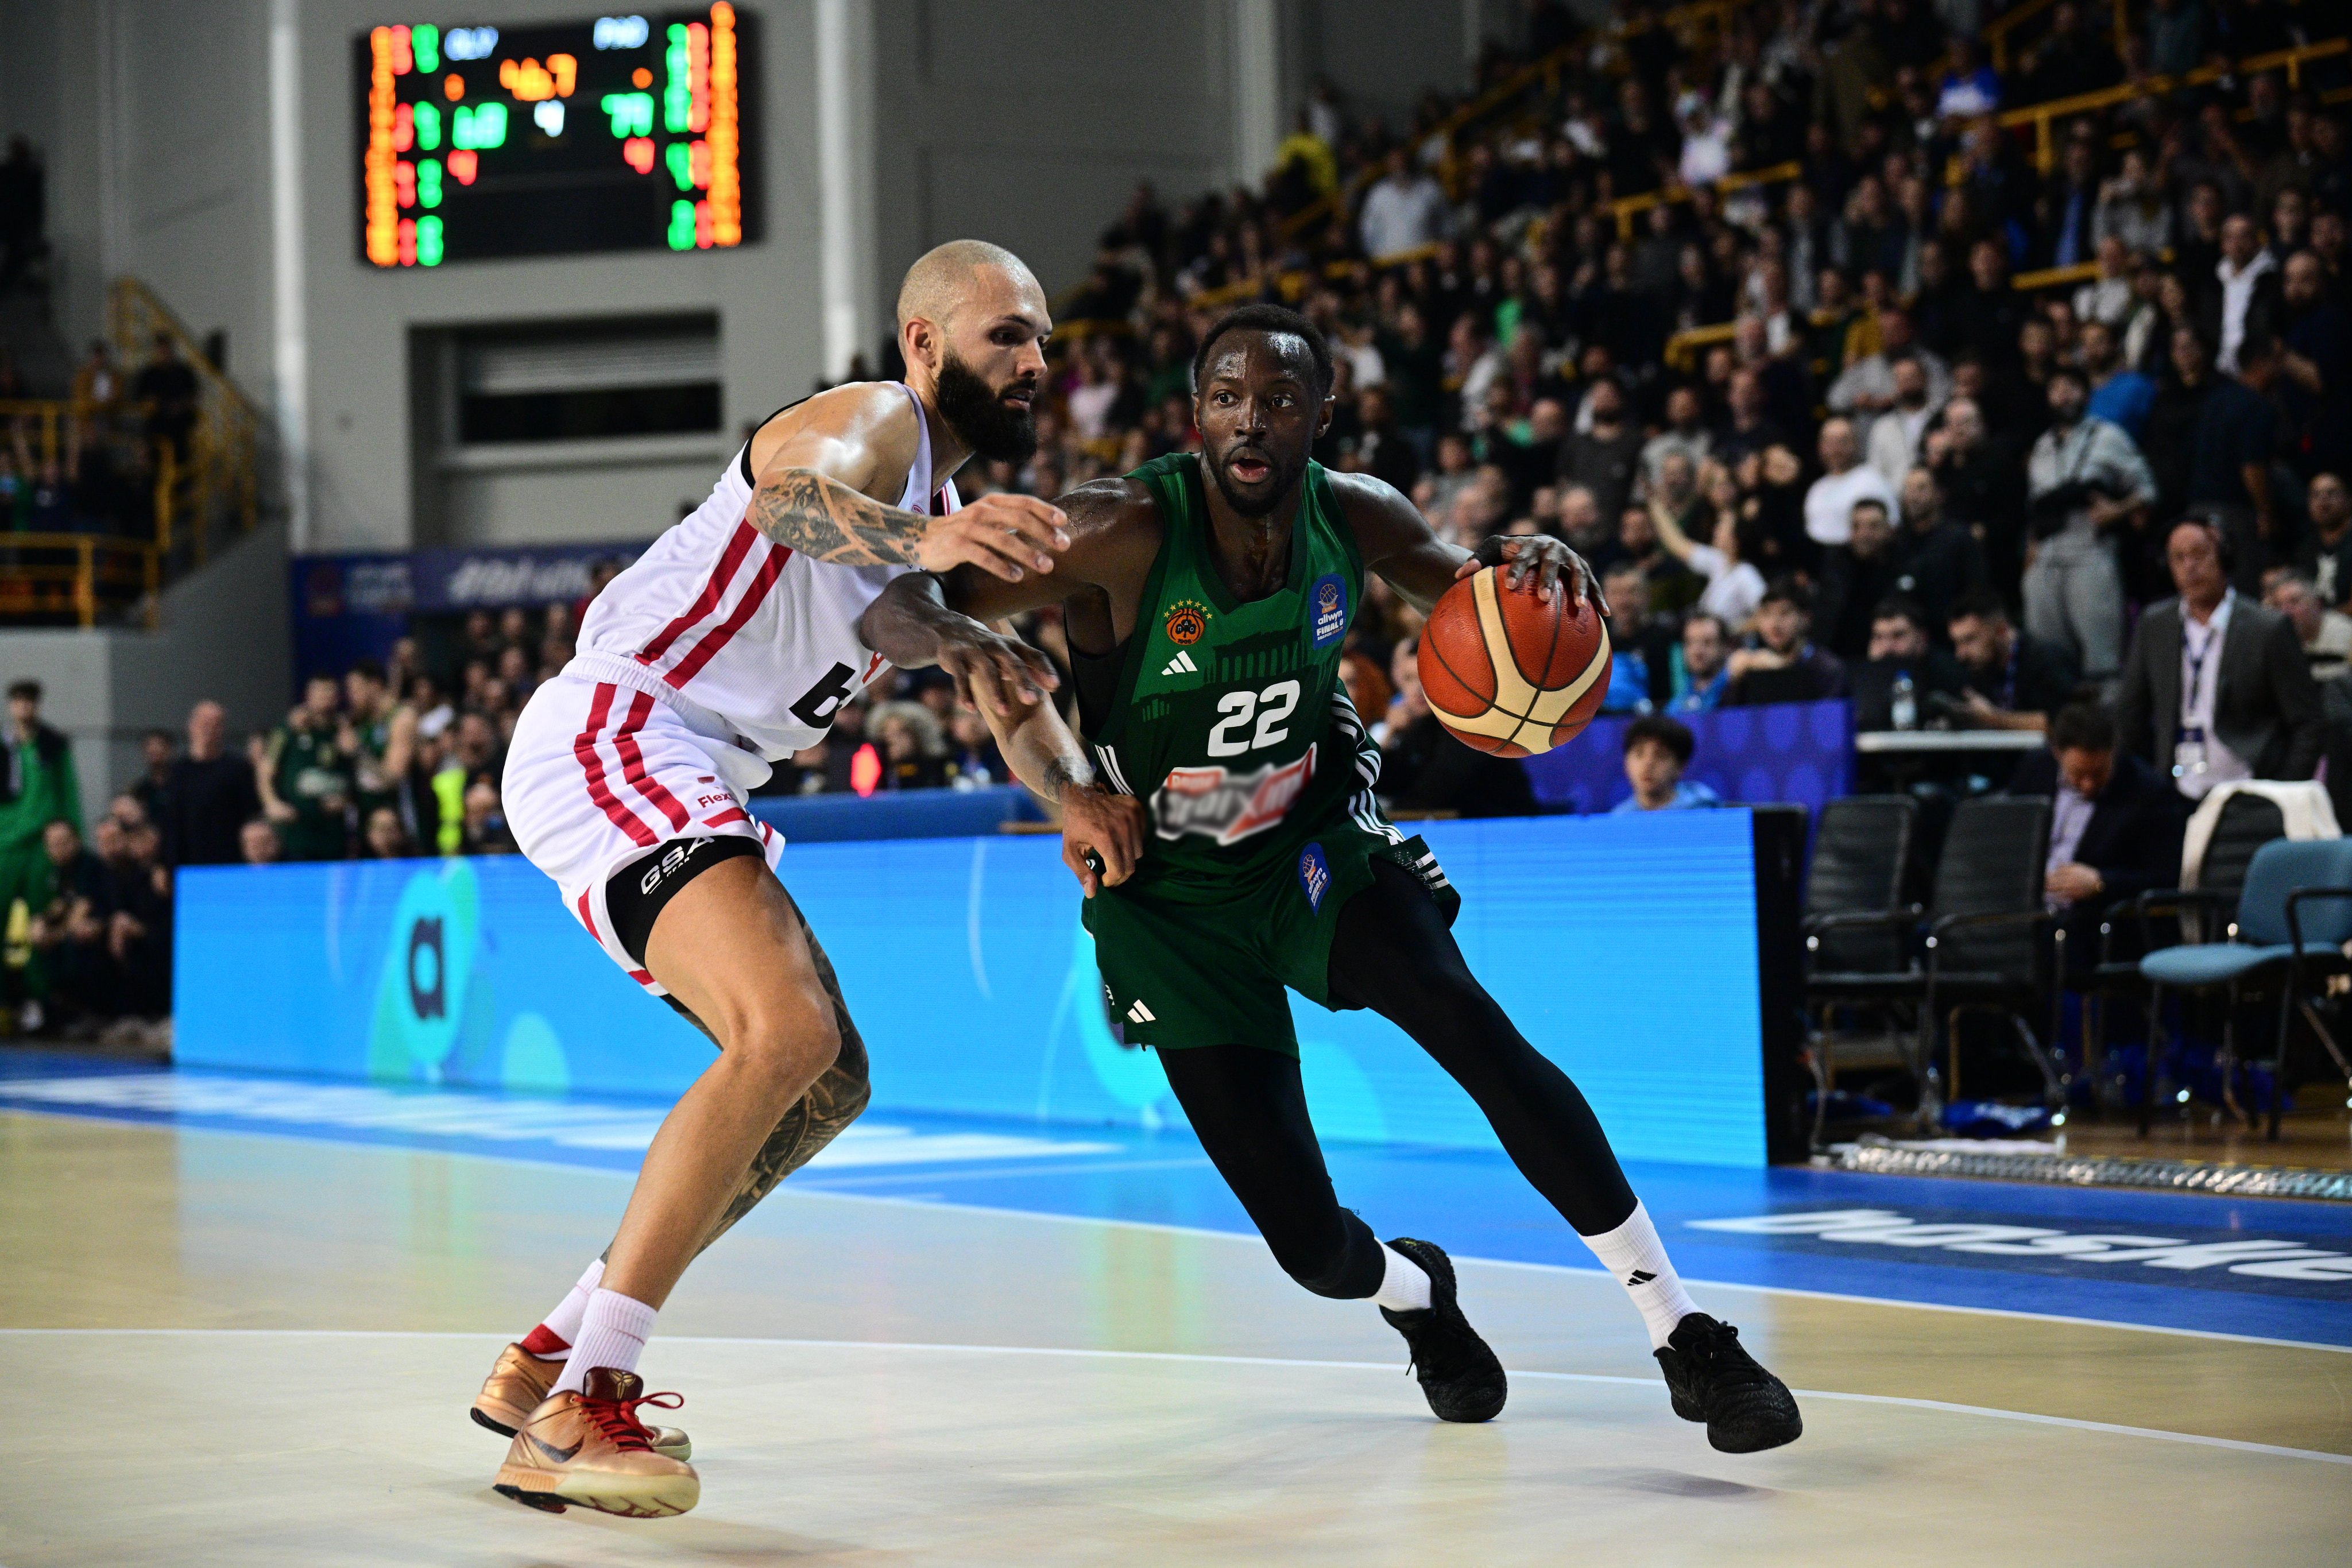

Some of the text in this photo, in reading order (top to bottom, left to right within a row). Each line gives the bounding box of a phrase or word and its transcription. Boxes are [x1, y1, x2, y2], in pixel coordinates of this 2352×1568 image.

[1317, 622, 1339, 636] FINAL
[1318, 610, 1343, 625] allwyn
[1207, 679, 1300, 756] 22
[641, 837, 715, 895] GSA
[1309, 868, 1323, 894] allwyn
[1311, 881, 1322, 903] FINAL
